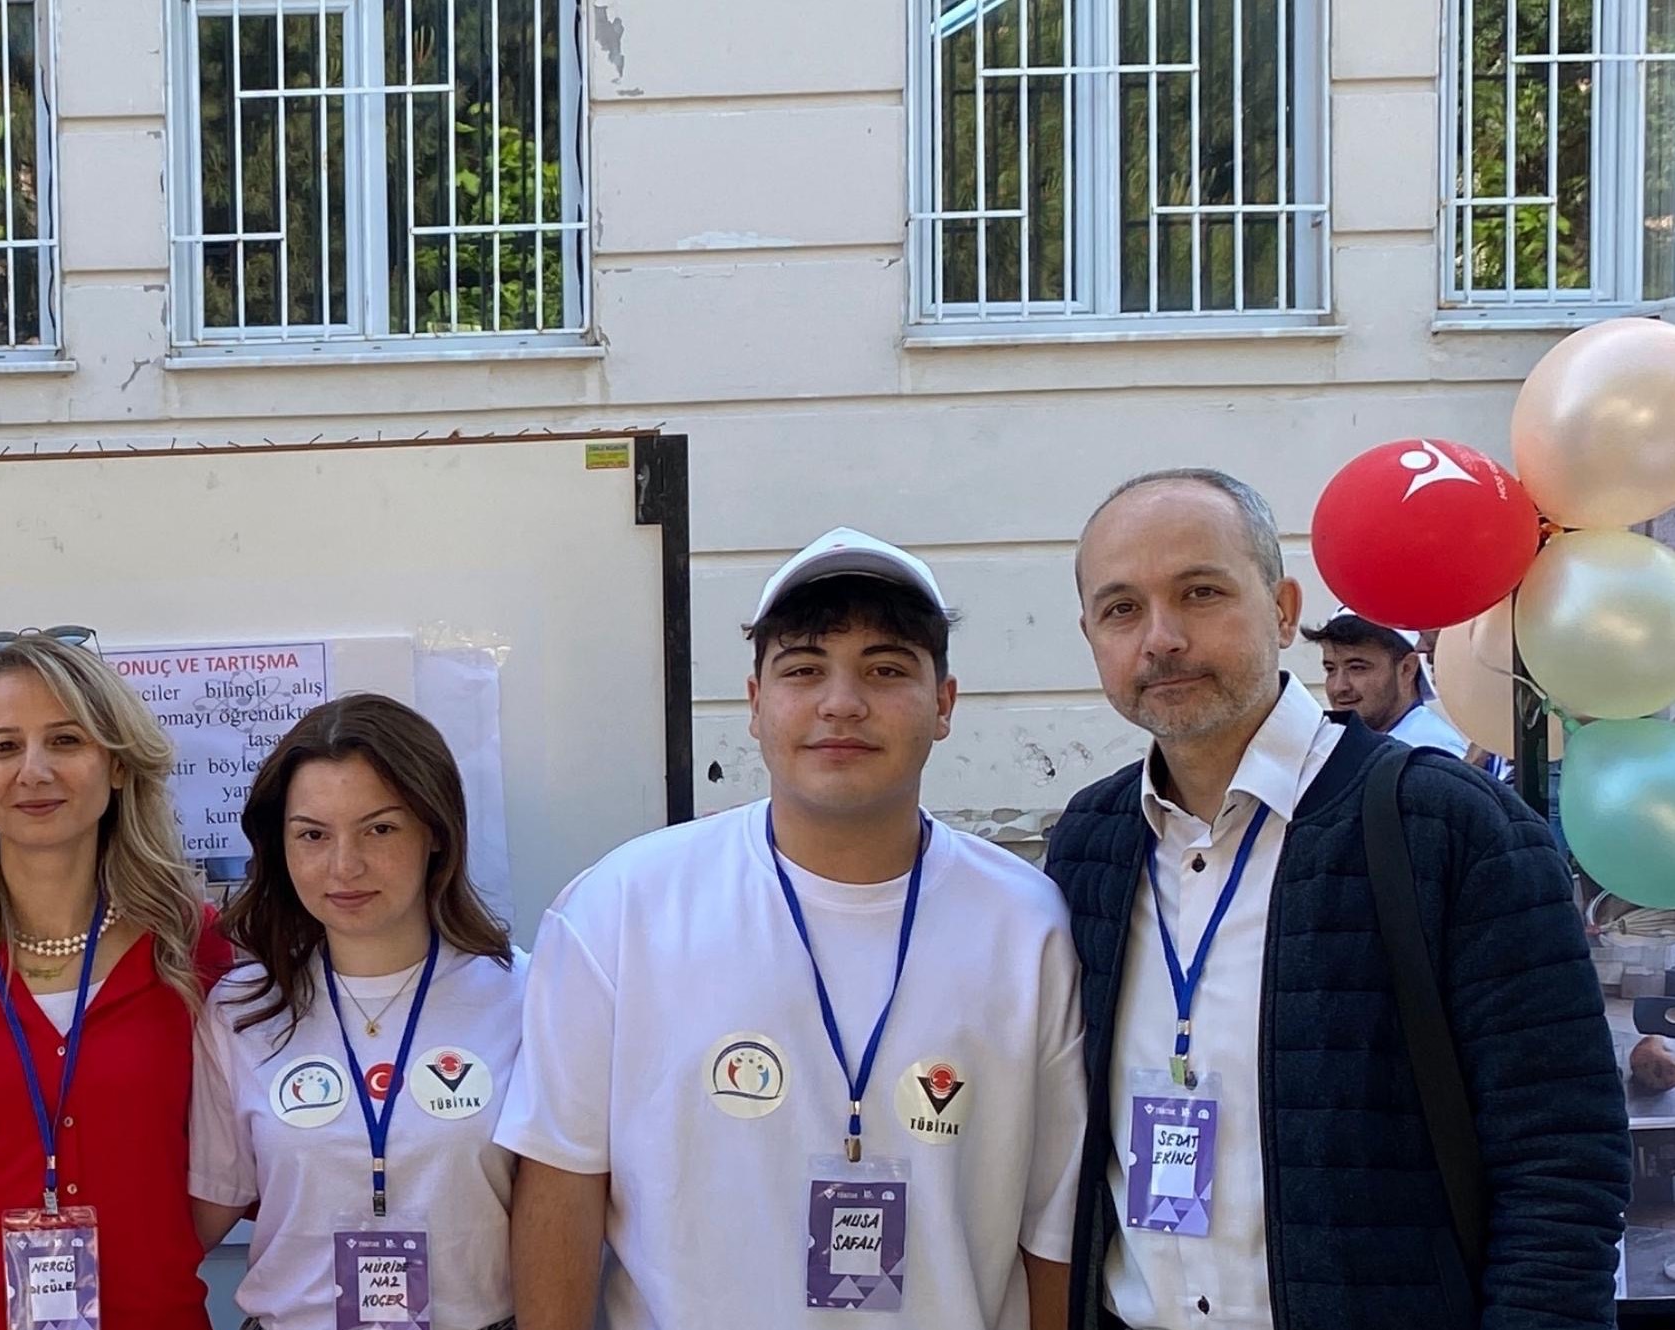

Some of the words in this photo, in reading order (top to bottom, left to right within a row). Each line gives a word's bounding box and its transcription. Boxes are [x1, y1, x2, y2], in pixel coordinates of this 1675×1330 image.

[176, 657, 200, 673] VE
[205, 652, 299, 674] TARTIŞMA
[140, 684, 181, 702] ciler
[156, 713, 211, 730] pmayı
[219, 702, 310, 727] öğrendikte
[248, 733, 283, 748] tasa
[221, 784, 253, 803] yap
[205, 807, 242, 825] kum
[181, 831, 229, 850] lerdir
[429, 1096, 480, 1111] TÜBİTAK
[910, 1116, 959, 1135] TÜBİTAK
[1157, 1130, 1201, 1148] SEDAT
[834, 1213, 880, 1229] MUSA
